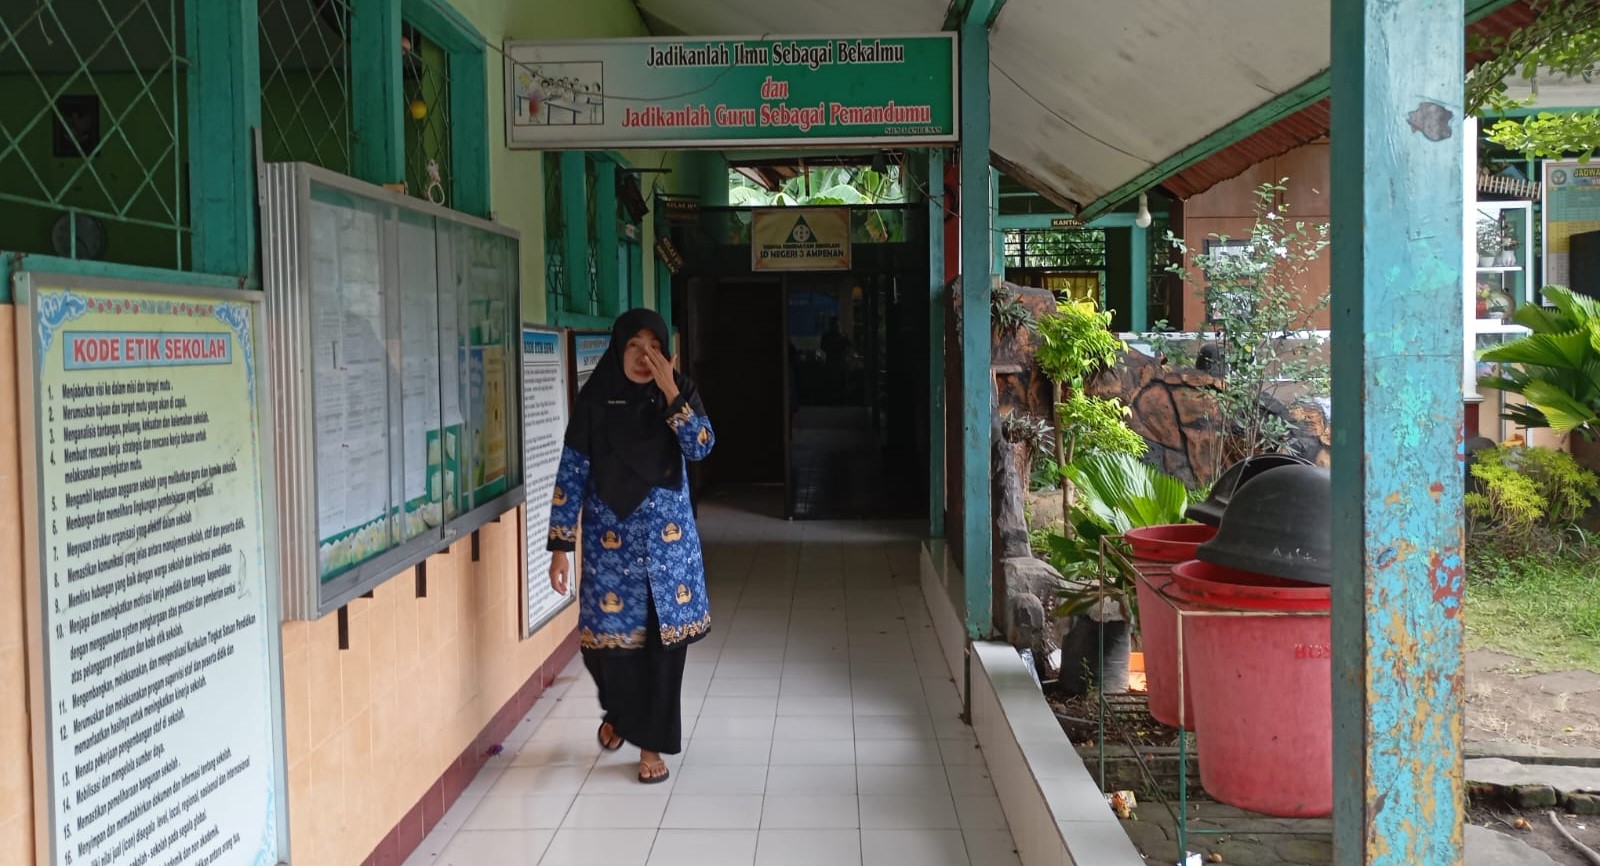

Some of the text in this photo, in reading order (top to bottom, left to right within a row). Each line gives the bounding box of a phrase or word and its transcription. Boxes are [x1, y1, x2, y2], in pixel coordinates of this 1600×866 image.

[647, 40, 904, 69] Jadikanlah Ilmu Sebagai Bekalmu
[760, 76, 788, 99] dan
[621, 101, 931, 132] Jadikanlah Guru Sebagai Pemandumu
[770, 250, 797, 258] NEGERI
[74, 338, 226, 362] KODE ETIK SEKOLAH
